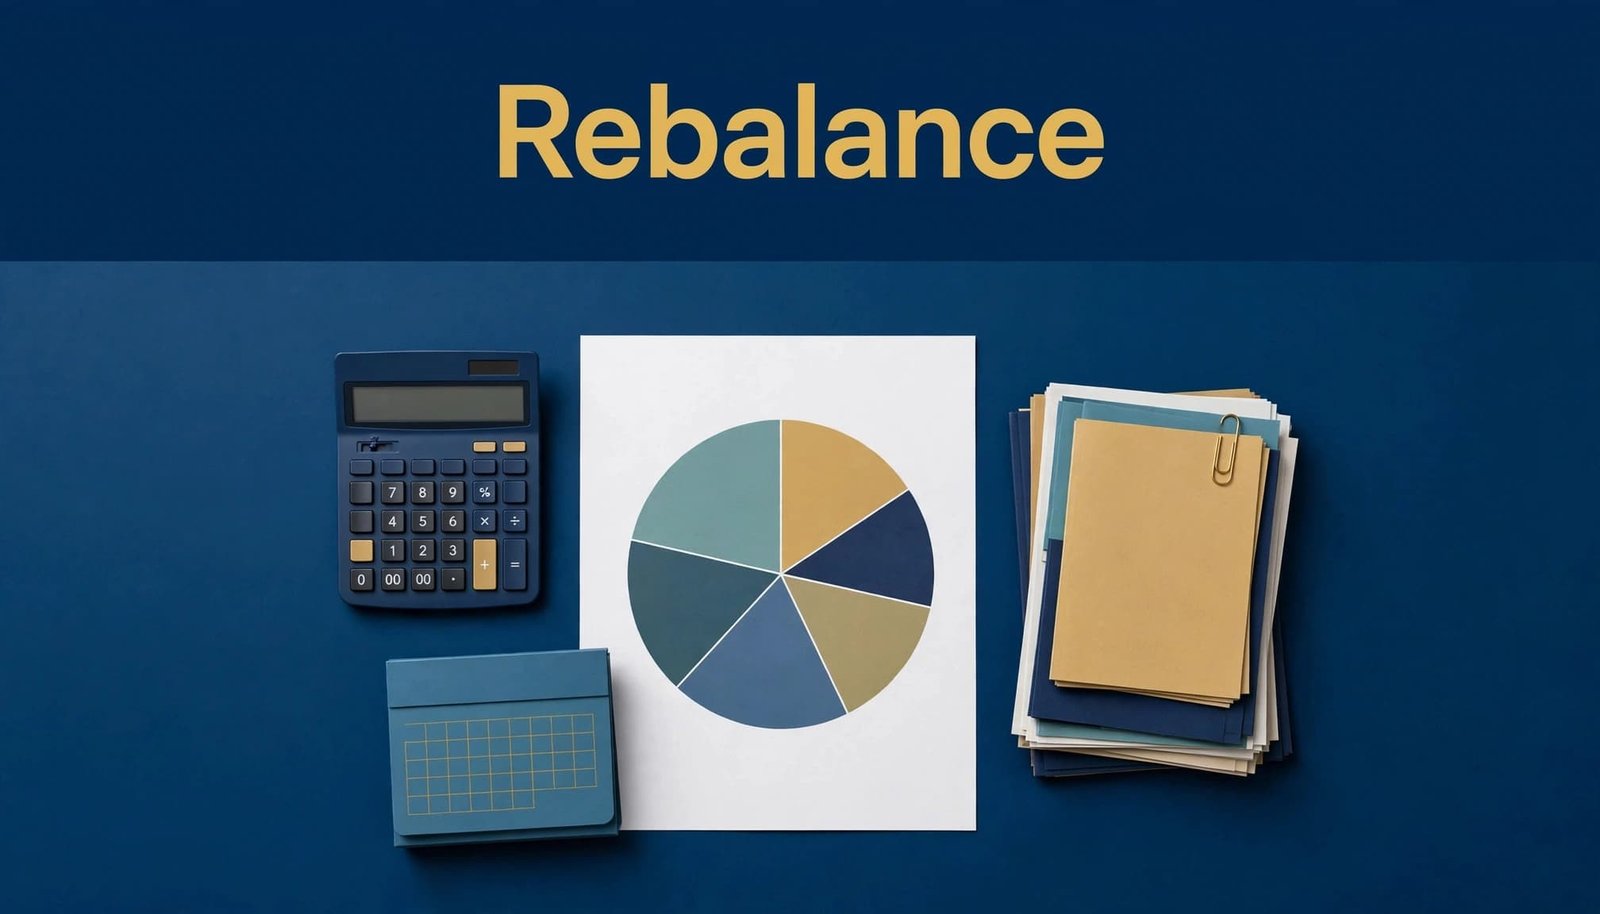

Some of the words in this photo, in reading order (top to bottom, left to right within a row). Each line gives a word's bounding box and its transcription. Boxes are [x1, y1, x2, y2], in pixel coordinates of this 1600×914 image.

[388, 486, 397, 498] 7
[418, 486, 427, 499] 8
[448, 486, 457, 498] 9
[479, 486, 491, 498] %
[388, 516, 397, 527] 4
[418, 516, 427, 527] 5
[448, 516, 457, 527] 6
[390, 545, 396, 557] 1
[418, 545, 427, 557] 2
[448, 545, 457, 557] 3
[357, 574, 366, 586] 0
[385, 574, 401, 586] 00
[415, 574, 431, 585] 00
